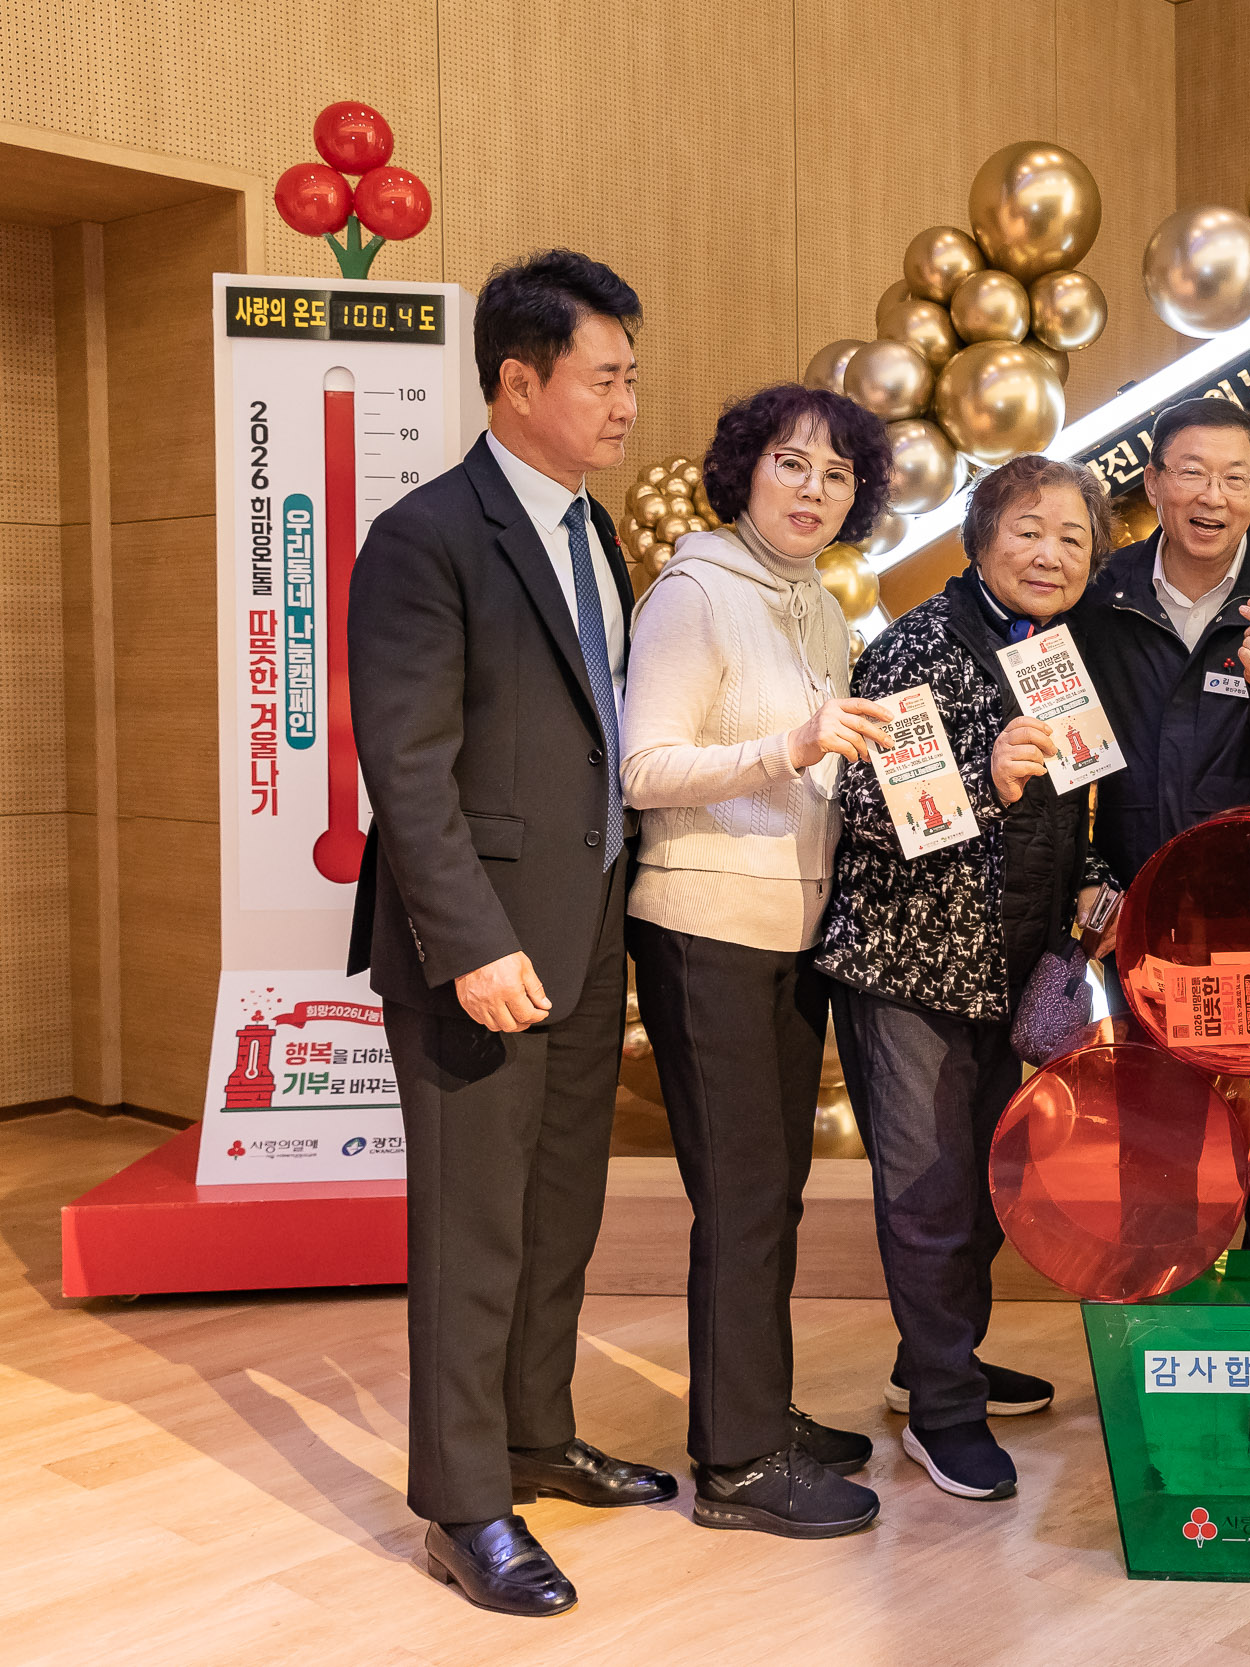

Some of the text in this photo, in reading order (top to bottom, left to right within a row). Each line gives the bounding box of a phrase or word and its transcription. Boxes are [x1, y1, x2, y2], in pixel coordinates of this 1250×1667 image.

[235, 296, 286, 327] 사랑의
[293, 298, 327, 328] 온도
[398, 388, 426, 401] 100
[400, 428, 419, 441] 90
[400, 471, 420, 484] 80
[286, 509, 313, 738] 우리동네 나눔캠페인
[249, 609, 278, 695] 따뜻한
[1016, 665, 1037, 678] 2026
[1019, 660, 1076, 694] 따뜻한
[1027, 676, 1081, 706] 겨울나기
[880, 724, 894, 734] 26
[250, 703, 279, 816] 겨울나기
[881, 739, 940, 768] 겨울나기
[306, 1004, 383, 1023] 희망2026나눔
[1202, 975, 1222, 1037] 따뜻한
[1221, 975, 1236, 1035] 겨울나기
[1194, 1014, 1202, 1036] 2026
[285, 1041, 348, 1066] 행복을
[282, 1071, 397, 1095] 기부로 바꾸는
[372, 1137, 406, 1148] 광진
